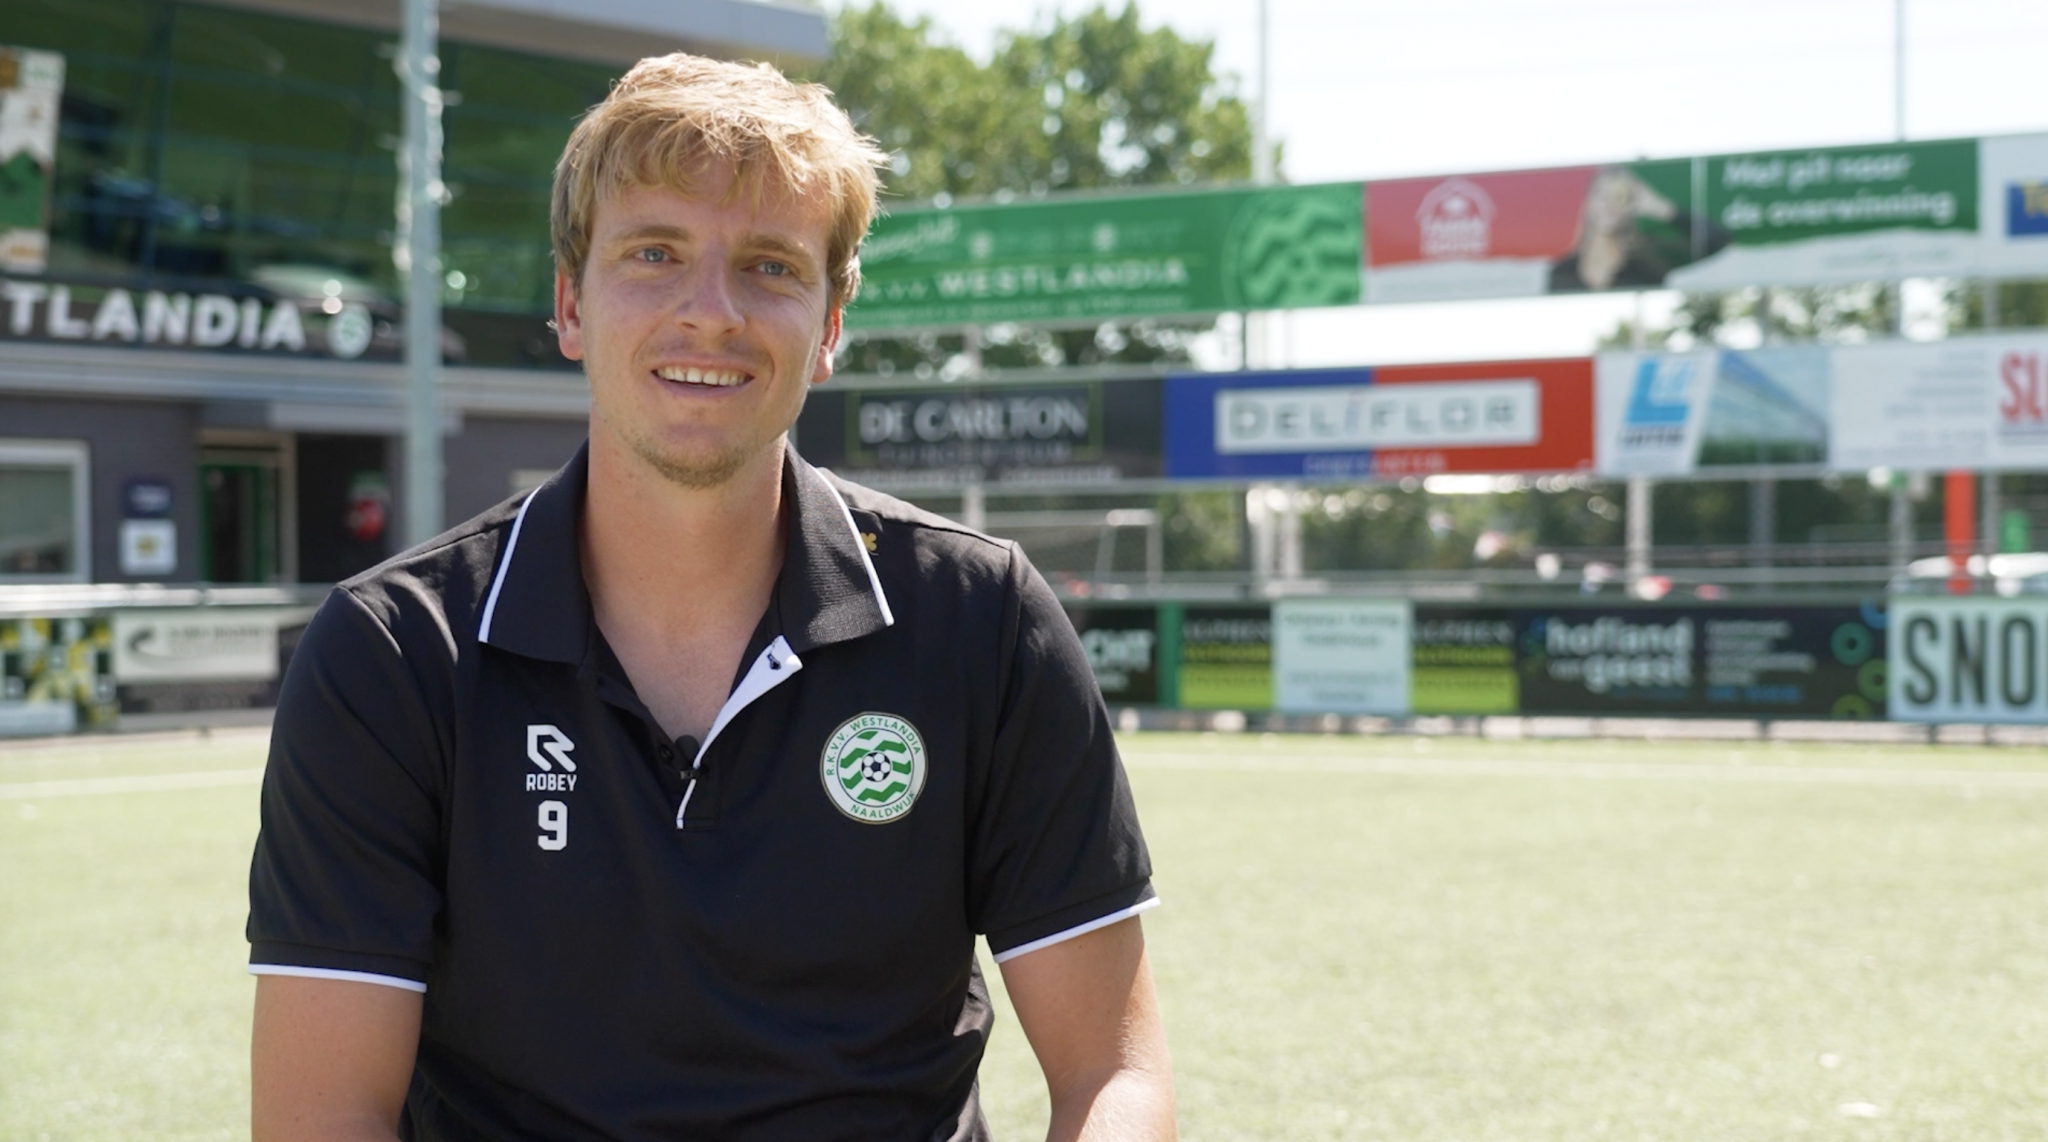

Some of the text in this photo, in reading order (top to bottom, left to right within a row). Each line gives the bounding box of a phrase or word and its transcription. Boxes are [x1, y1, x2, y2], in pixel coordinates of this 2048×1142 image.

[933, 257, 1188, 298] WESTLANDIA
[2, 281, 306, 350] TLANDIA
[859, 396, 1089, 443] DE CARLTON
[1546, 617, 1694, 656] hofland
[1583, 653, 1694, 694] geest
[1903, 613, 2048, 709] SNO
[826, 733, 849, 776] R.K.V.V.
[850, 717, 921, 755] WESTLANDIA
[526, 773, 577, 792] ROBEY
[850, 791, 915, 818] NAALDWIJK
[538, 800, 568, 851] 9
